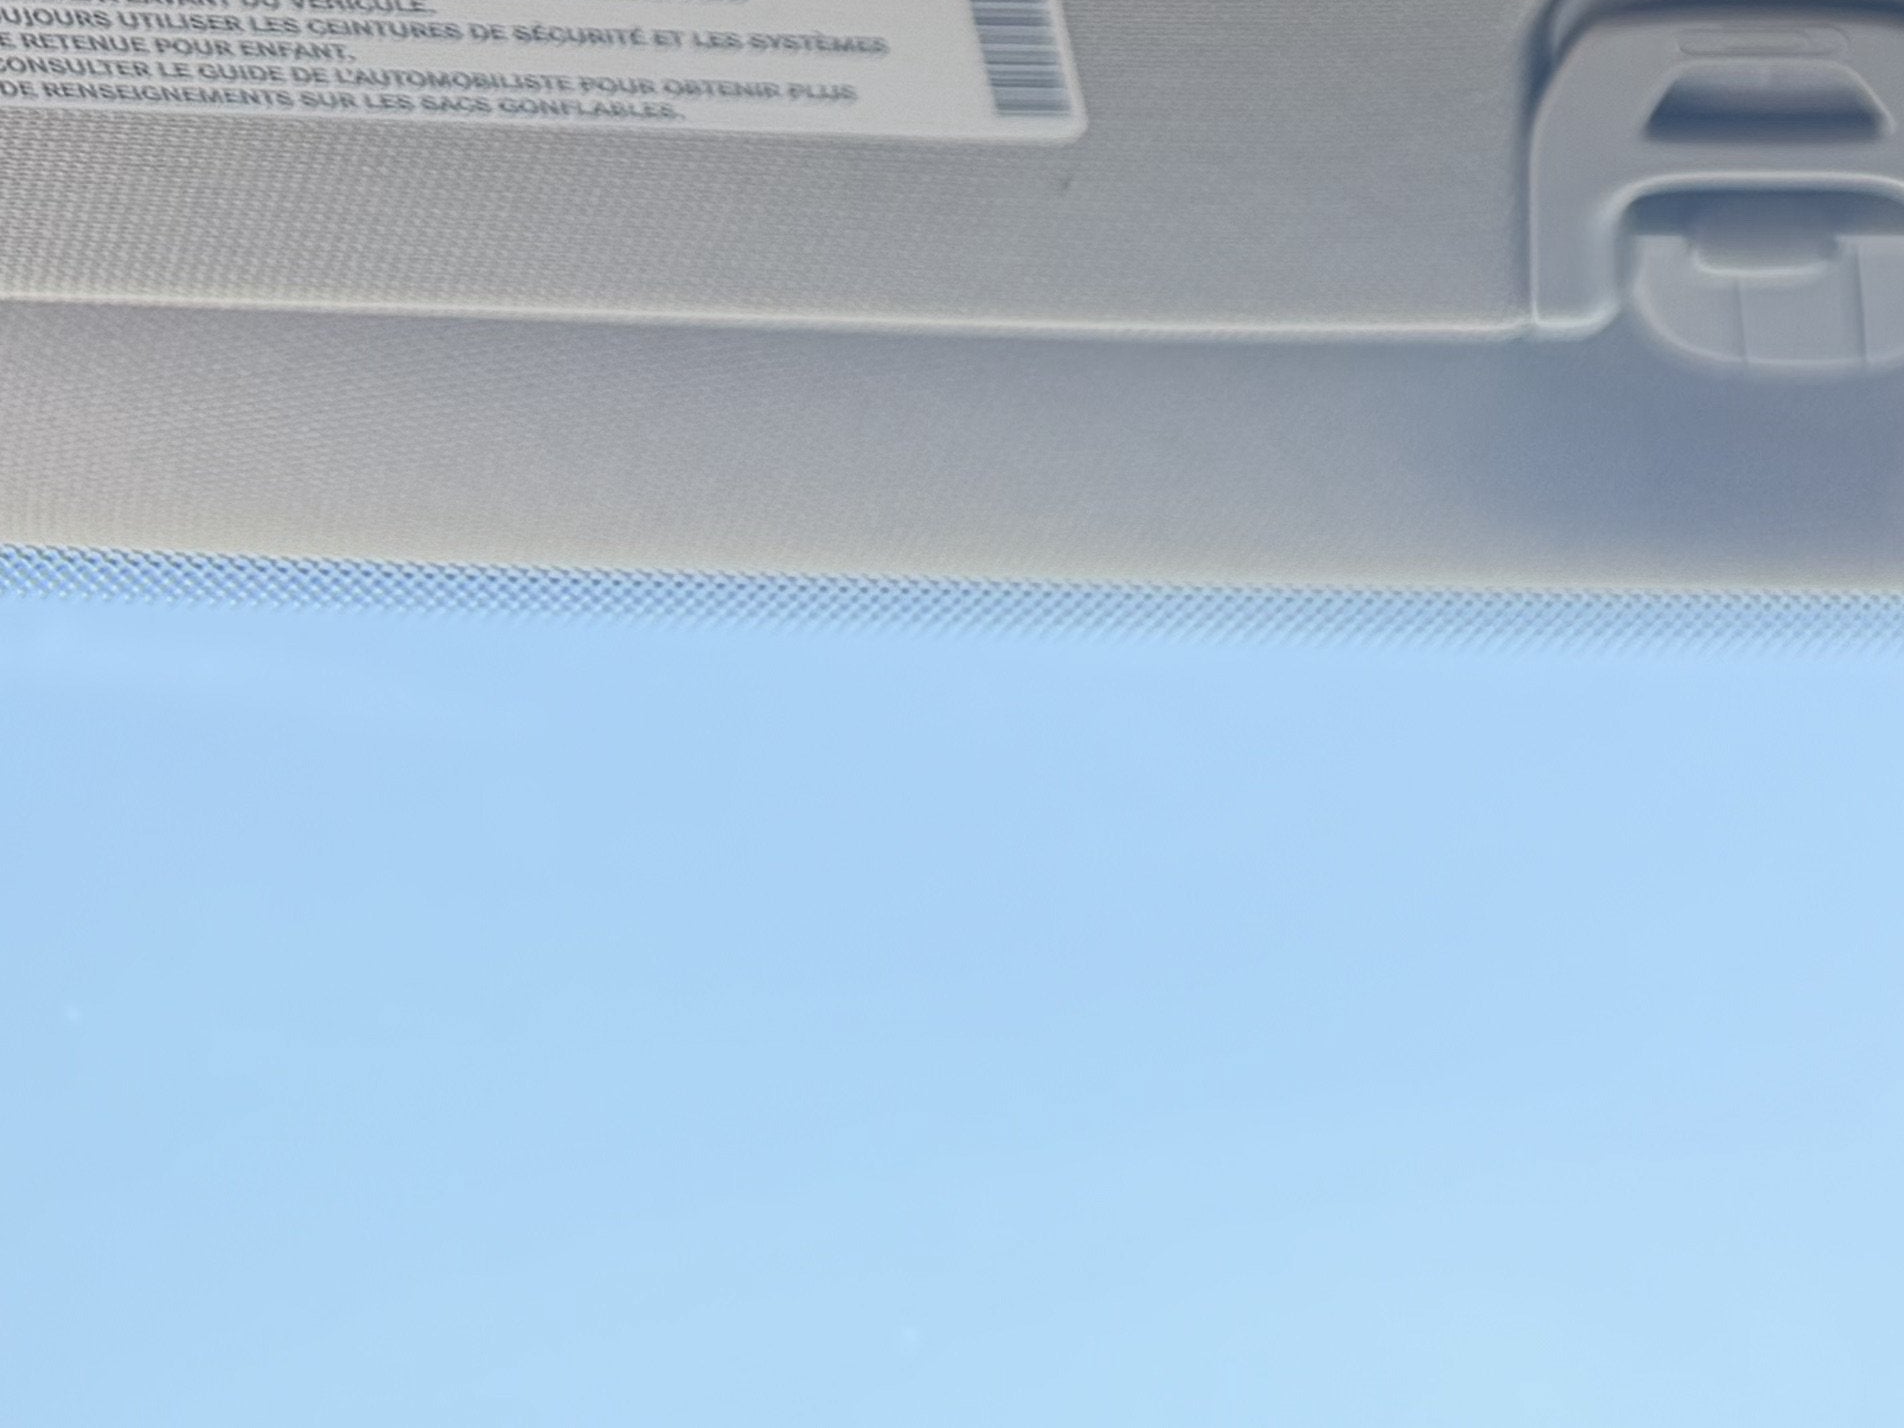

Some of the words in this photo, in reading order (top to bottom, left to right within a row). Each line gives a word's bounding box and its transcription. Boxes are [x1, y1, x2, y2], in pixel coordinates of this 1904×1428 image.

[0, 7, 112, 28] UJOURS
[118, 11, 245, 32] UTILISER
[250, 15, 302, 35] LES
[307, 18, 465, 40] CEINTURES
[467, 23, 509, 42] DE
[652, 29, 683, 47] ET
[692, 30, 743, 50] LES
[20, 33, 151, 53] RETENUE
[153, 37, 236, 57] POUR
[240, 40, 356, 61] ENFANT.
[0, 79, 35, 99] DE
[41, 80, 295, 107] RENSEIGNEMENTS
[300, 91, 359, 109] SUR
[363, 94, 415, 111] LES
[420, 96, 493, 114] SACS
[157, 61, 194, 78] LE
[199, 62, 286, 82] GUIDE
[291, 65, 331, 83] DE
[578, 75, 658, 95] POUR
[786, 81, 859, 102] PLUS
